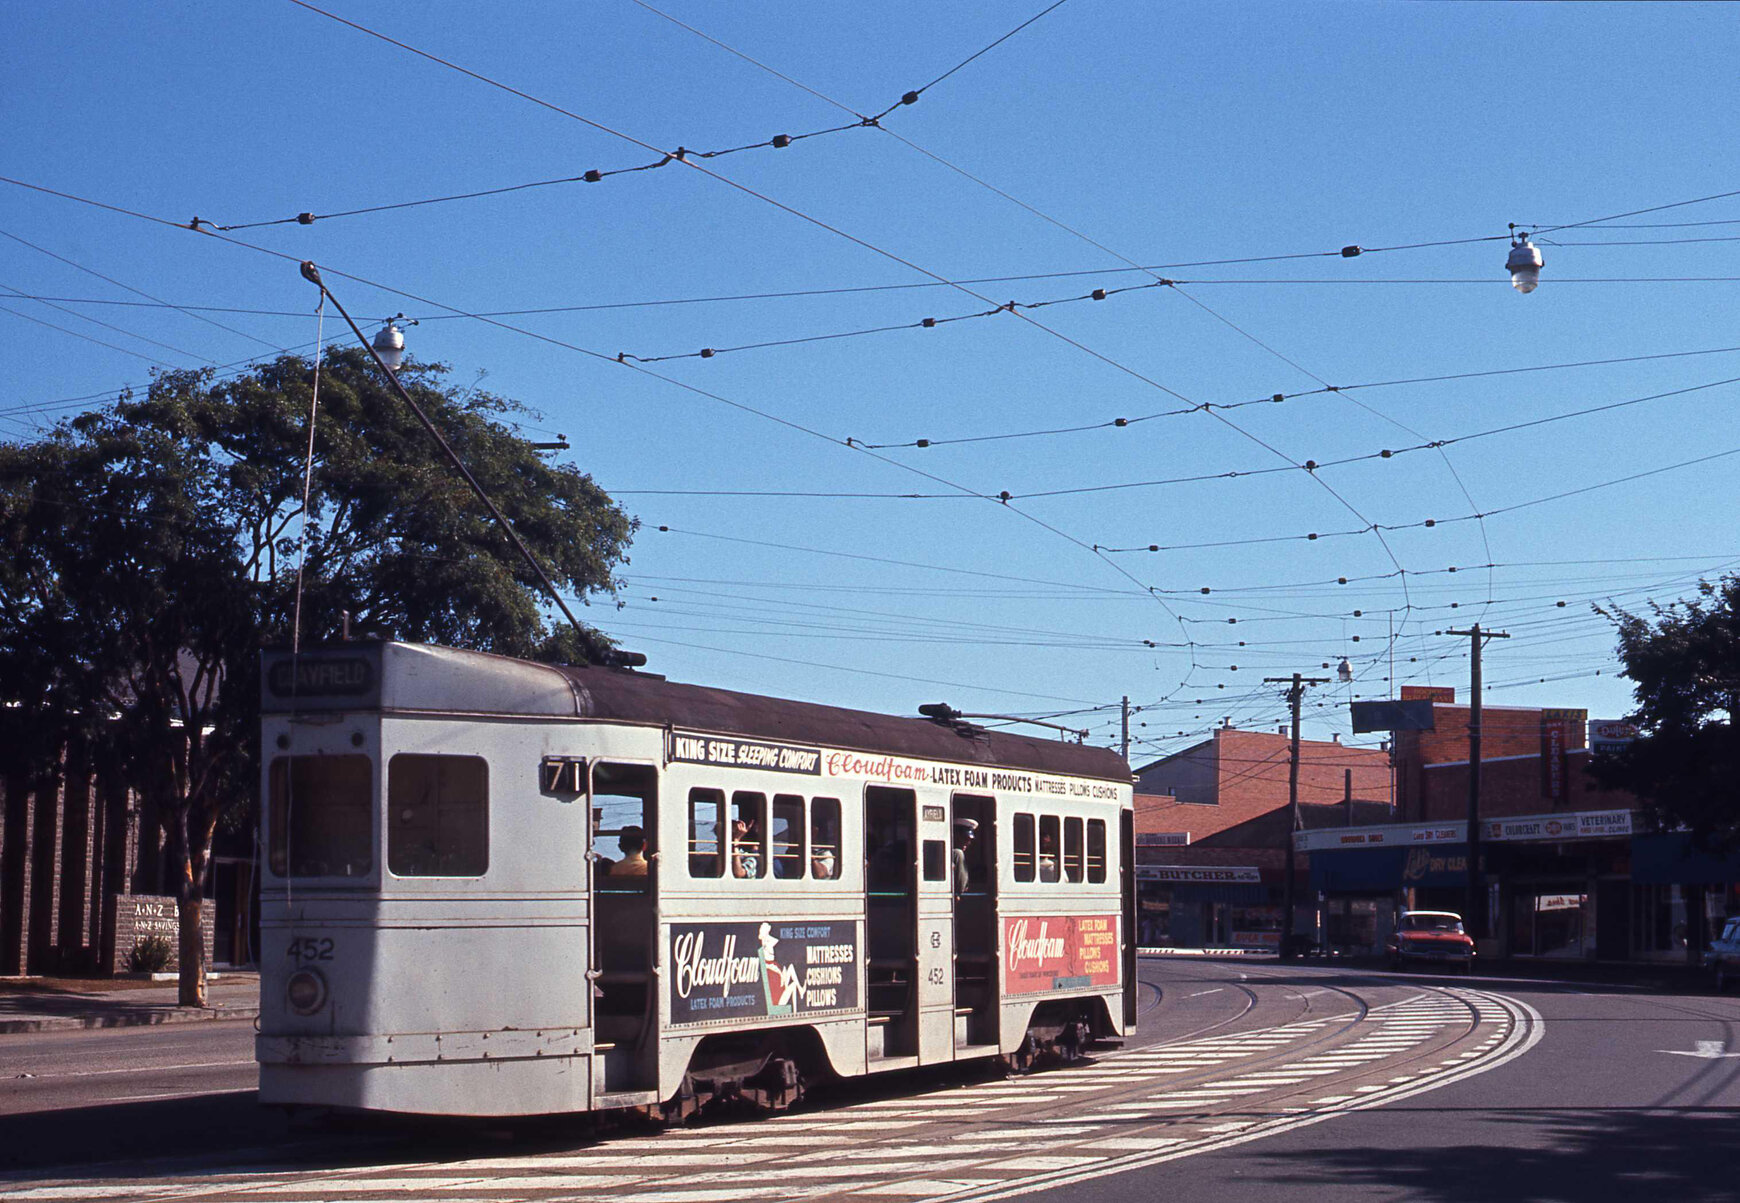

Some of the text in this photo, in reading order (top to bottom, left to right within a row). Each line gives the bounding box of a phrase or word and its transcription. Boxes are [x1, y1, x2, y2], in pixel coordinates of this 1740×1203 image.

[676, 737, 819, 771] KING SIZE SLEEPING COMFORT
[1600, 744, 1627, 753] PAINT
[825, 752, 929, 781] Cloudfoam
[547, 761, 580, 792] 71
[932, 766, 1118, 800] LATEX FOAM PRODUCTS MATTRESSES PILLOWS CUSHIONS
[1581, 814, 1625, 826] VETERINARY
[1159, 871, 1234, 880] BUTCHER
[780, 926, 831, 939] KING SIZE COMFORT
[1079, 919, 1107, 931] LATEX FOAM
[1009, 920, 1065, 971] Cloudfoam
[1084, 932, 1114, 945] MATTRESSES
[287, 937, 335, 963] 452
[806, 945, 853, 964] MATTRESSES
[1080, 946, 1101, 960] PILLOWS
[675, 931, 759, 998] Cloudfoam
[1084, 960, 1109, 974] CUSHIONS
[806, 967, 842, 986] CUSHIONS
[928, 968, 943, 985] 452
[690, 995, 755, 1010] LATEX FOAM PRODUCTS
[806, 988, 836, 1007] PILLOWS
